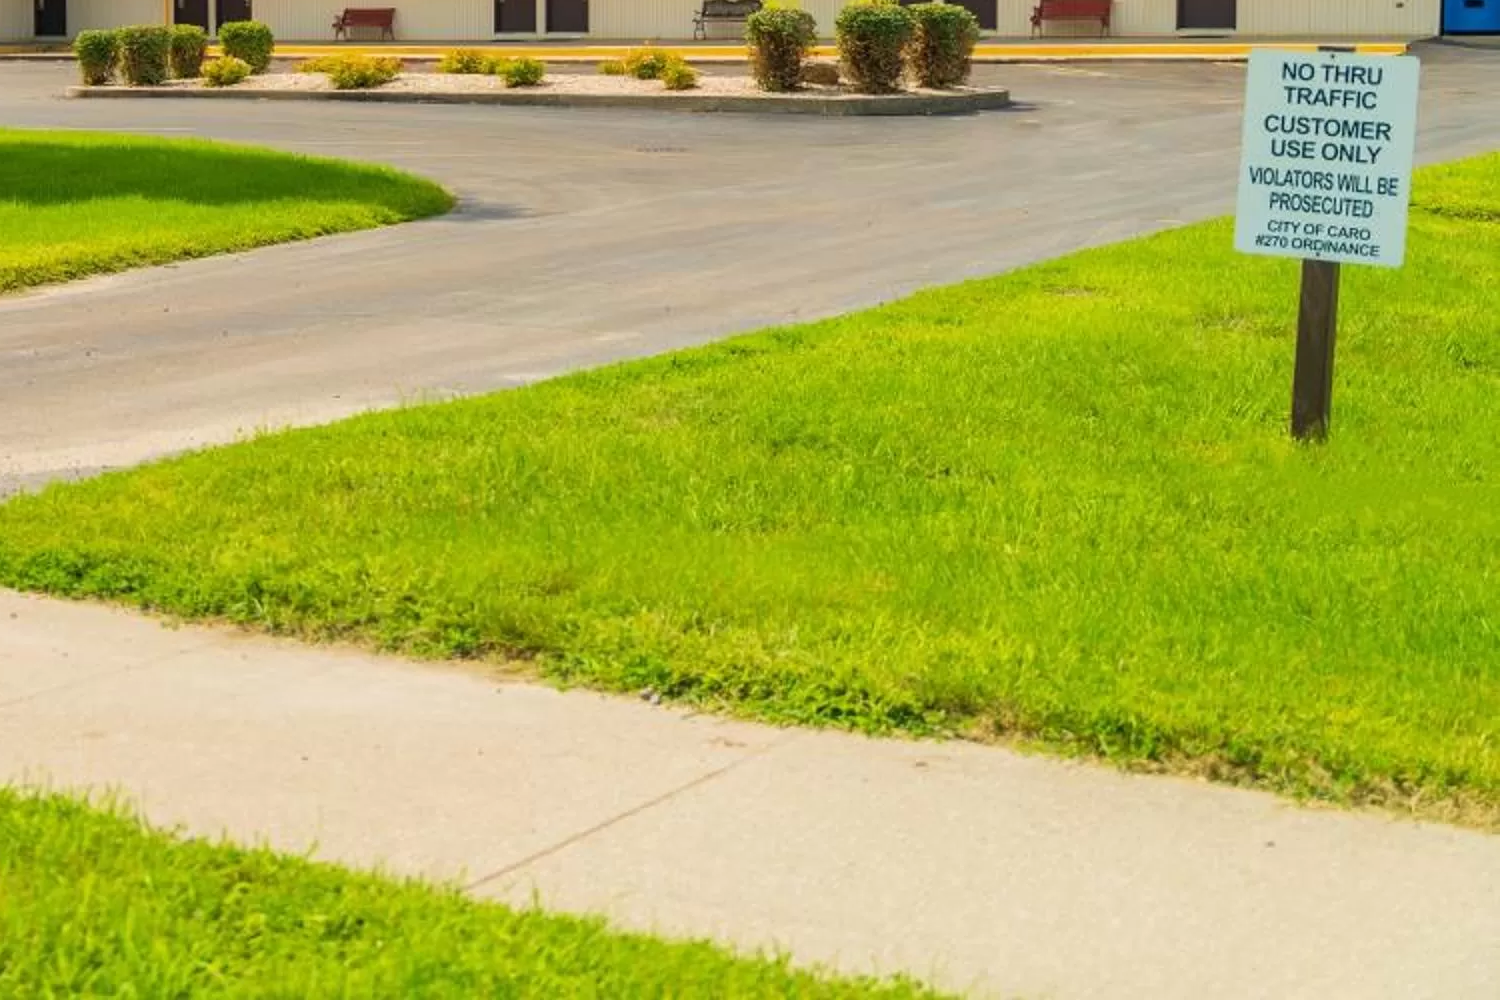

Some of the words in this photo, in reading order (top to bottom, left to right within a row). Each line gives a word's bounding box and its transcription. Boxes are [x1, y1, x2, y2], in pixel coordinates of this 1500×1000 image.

[1282, 62, 1315, 81] NO
[1320, 65, 1383, 85] THRU
[1284, 86, 1378, 109] TRAFFIC
[1264, 114, 1392, 141] CUSTOMER
[1271, 139, 1315, 159] USE
[1321, 143, 1382, 164] ONLY
[1249, 166, 1334, 191] VIOLATORS
[1337, 174, 1373, 194] WILL
[1377, 177, 1399, 196] BE
[1269, 192, 1373, 218] PROSECUTED
[1267, 219, 1301, 234] CITY
[1303, 223, 1324, 235] OF
[1327, 225, 1371, 241] CARO
[1255, 234, 1288, 248] #270
[1291, 238, 1380, 257] ORDINANCE
